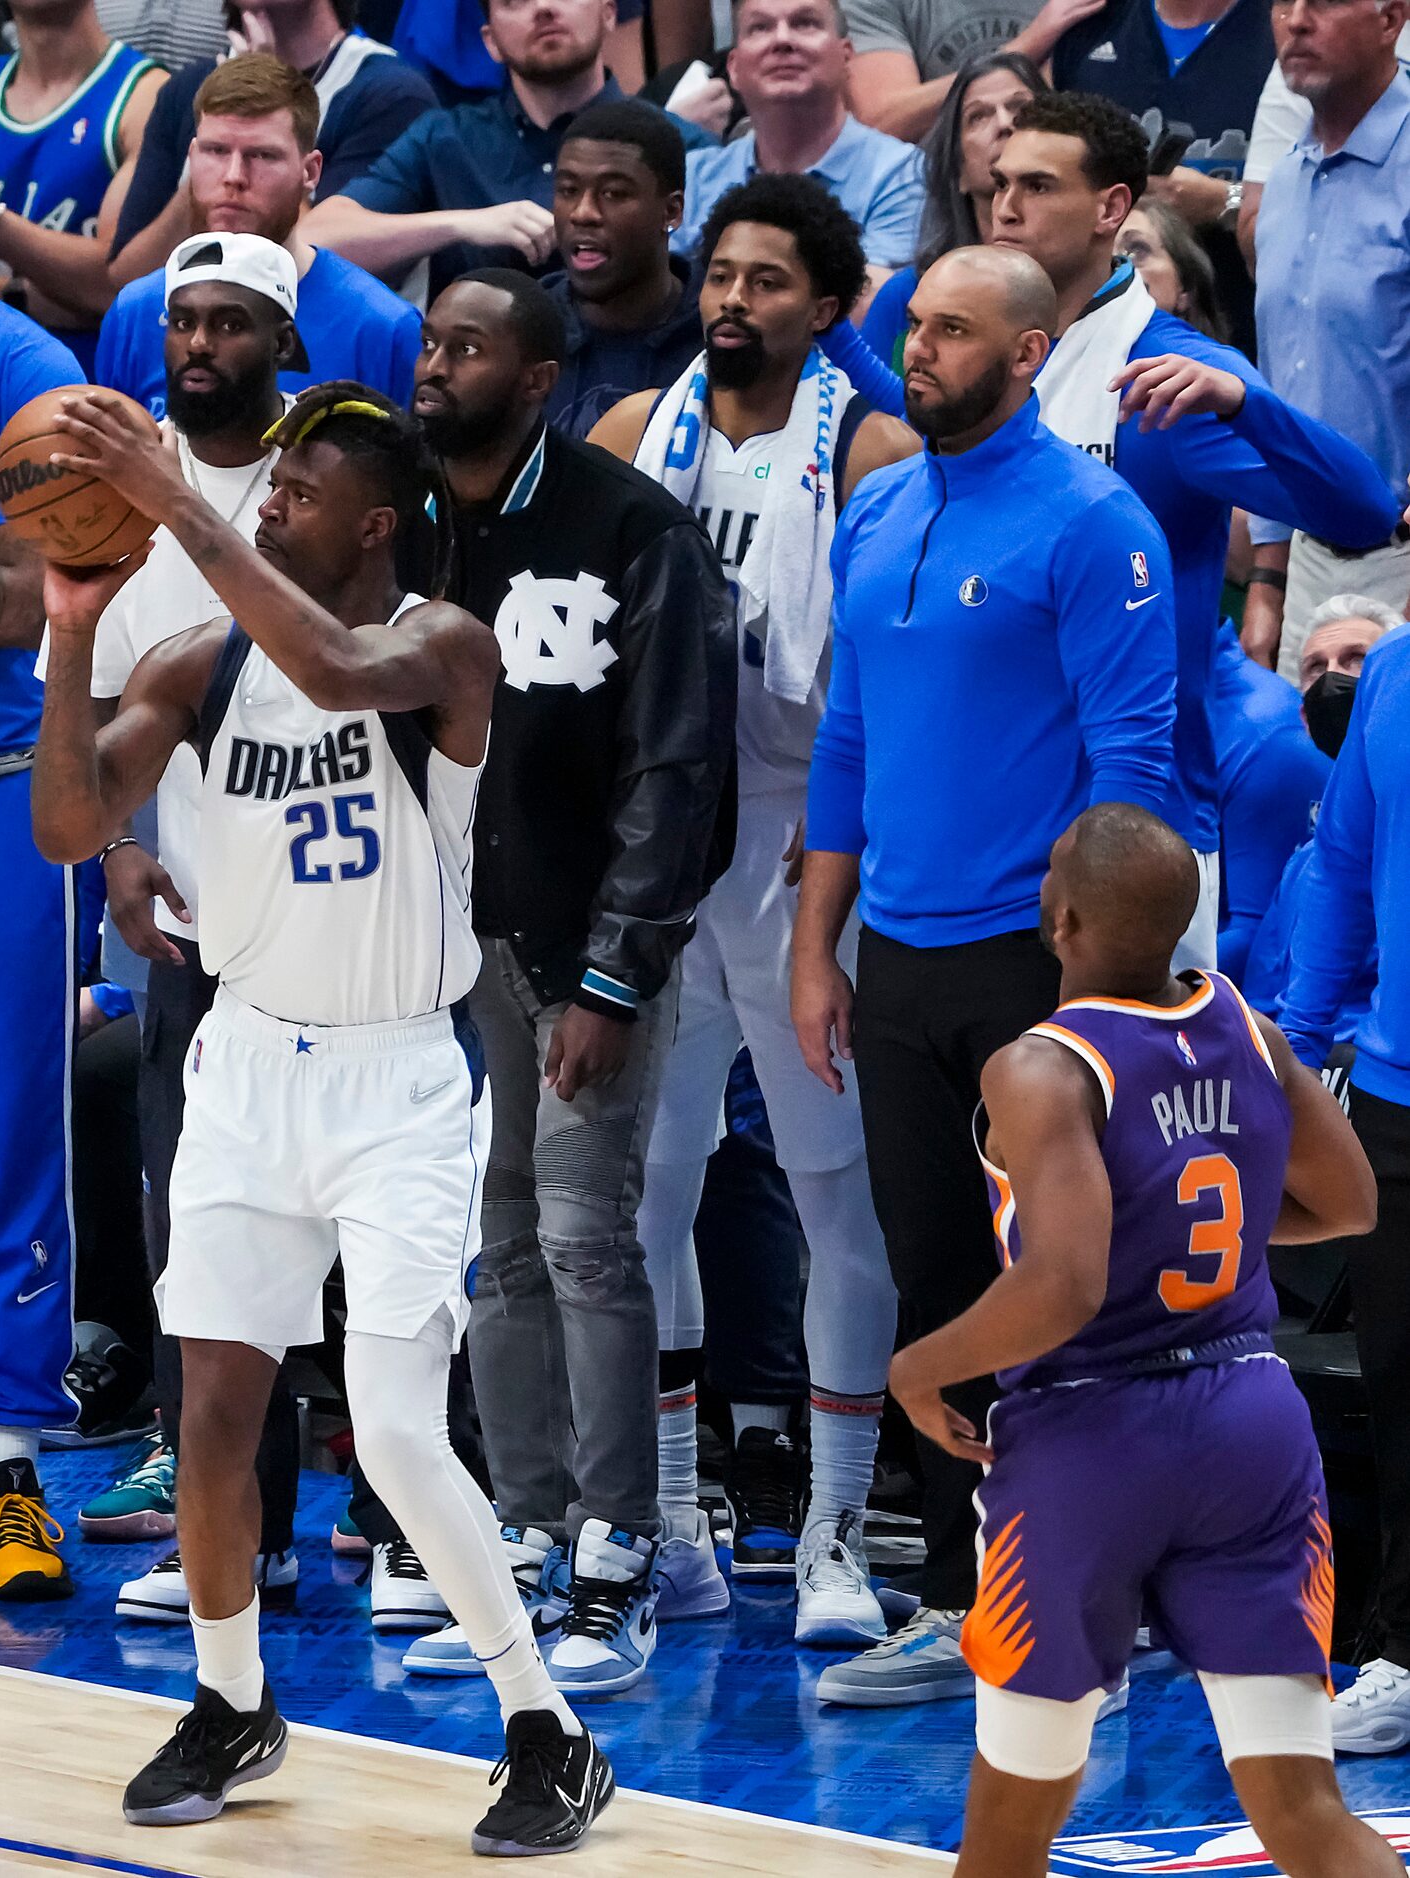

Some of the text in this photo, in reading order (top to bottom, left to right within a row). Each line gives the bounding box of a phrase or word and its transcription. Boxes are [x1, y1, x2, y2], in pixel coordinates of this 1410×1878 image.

[284, 791, 381, 884] 25
[1151, 1079, 1239, 1146] PAUL
[1158, 1153, 1244, 1313] 3
